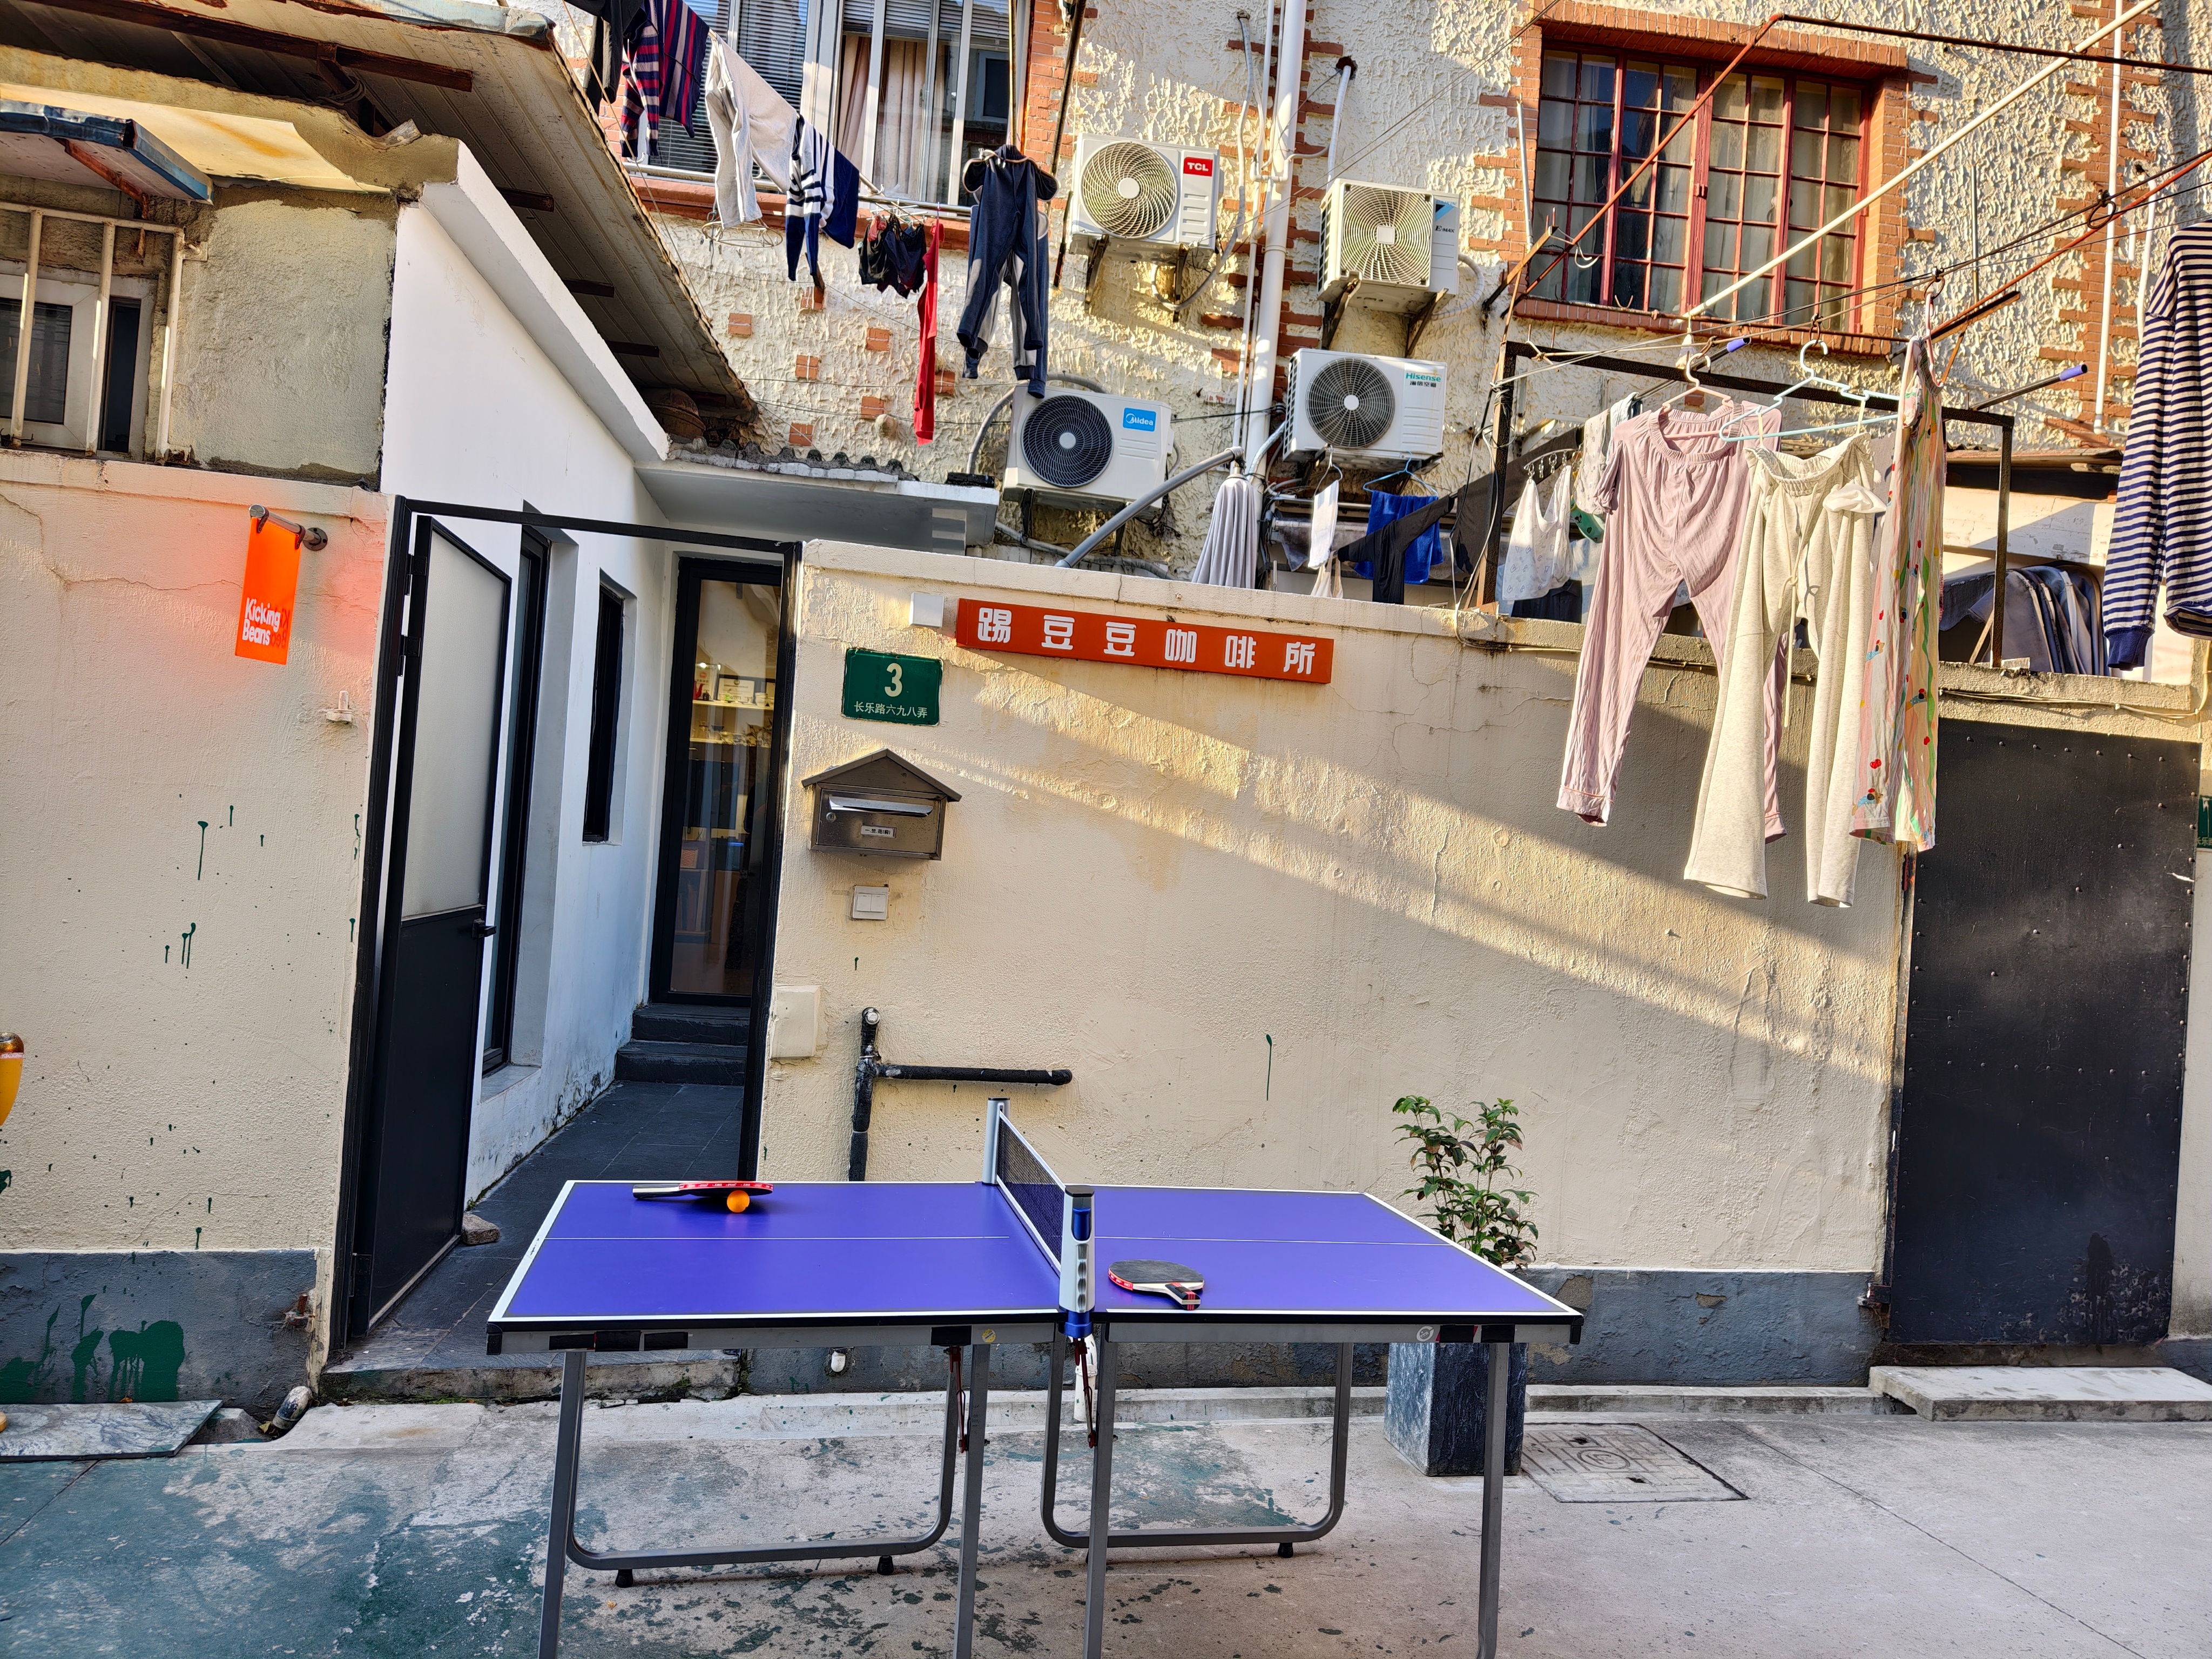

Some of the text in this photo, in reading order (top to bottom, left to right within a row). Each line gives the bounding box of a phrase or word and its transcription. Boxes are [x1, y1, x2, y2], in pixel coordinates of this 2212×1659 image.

[1187, 162, 1209, 172] TCL
[1406, 373, 1441, 382] Hisense
[1125, 413, 1154, 426] Midea
[245, 597, 280, 632] Kicking
[242, 618, 271, 645] Beans
[977, 607, 1316, 675] 踢豆豆咖啡所
[885, 663, 902, 697] 3
[854, 701, 928, 718] 长乐路六九八弄
